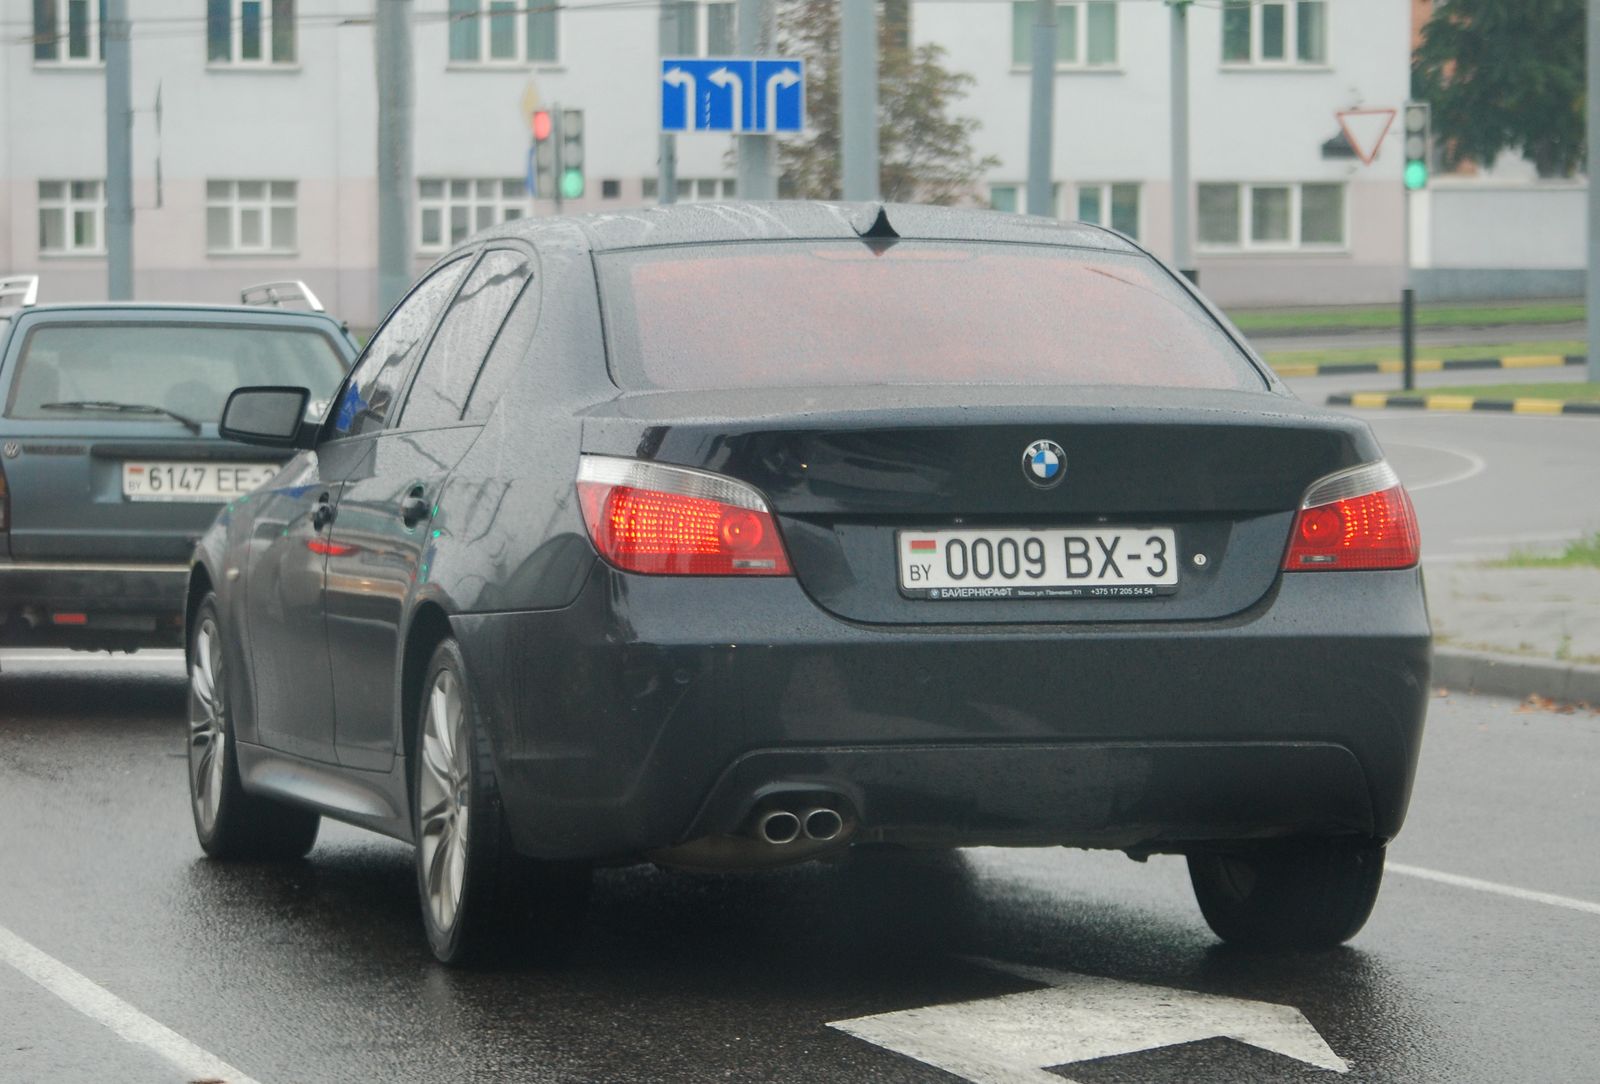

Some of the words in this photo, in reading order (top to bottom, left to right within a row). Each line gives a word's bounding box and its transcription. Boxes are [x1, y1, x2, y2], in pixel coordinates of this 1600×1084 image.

[150, 467, 206, 491] 6147
[945, 538, 1046, 580] 0009
[1064, 536, 1168, 579] BX-3
[910, 565, 931, 581] BY
[941, 587, 1013, 598] БАЙЕРНКРАФТ
[1090, 587, 1109, 595] +375
[1110, 587, 1119, 595] 17
[1120, 587, 1133, 595] 205
[1134, 587, 1143, 595] 54
[1144, 587, 1153, 595] 54
